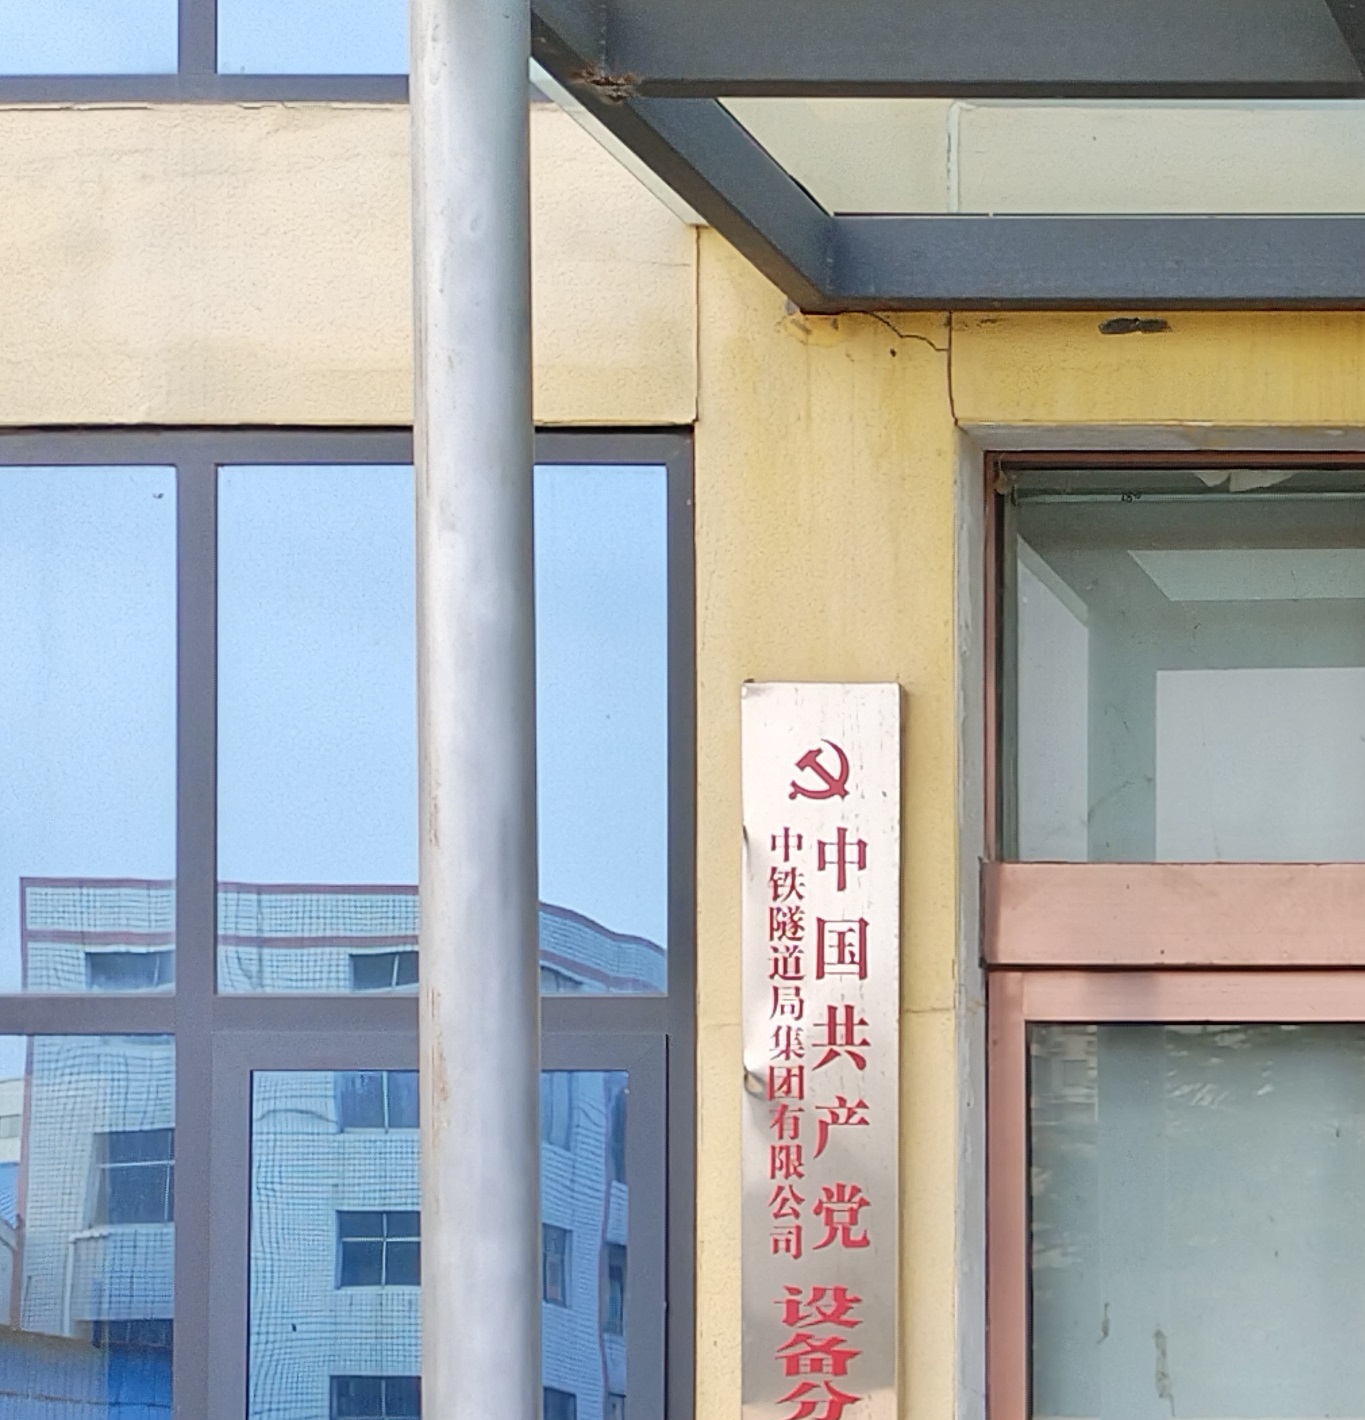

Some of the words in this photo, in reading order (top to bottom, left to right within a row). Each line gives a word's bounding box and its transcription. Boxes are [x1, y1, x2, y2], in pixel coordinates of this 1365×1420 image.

[767, 825, 806, 1260] 中铁隧道局集团有限公司
[811, 826, 871, 1250] 中国共产党
